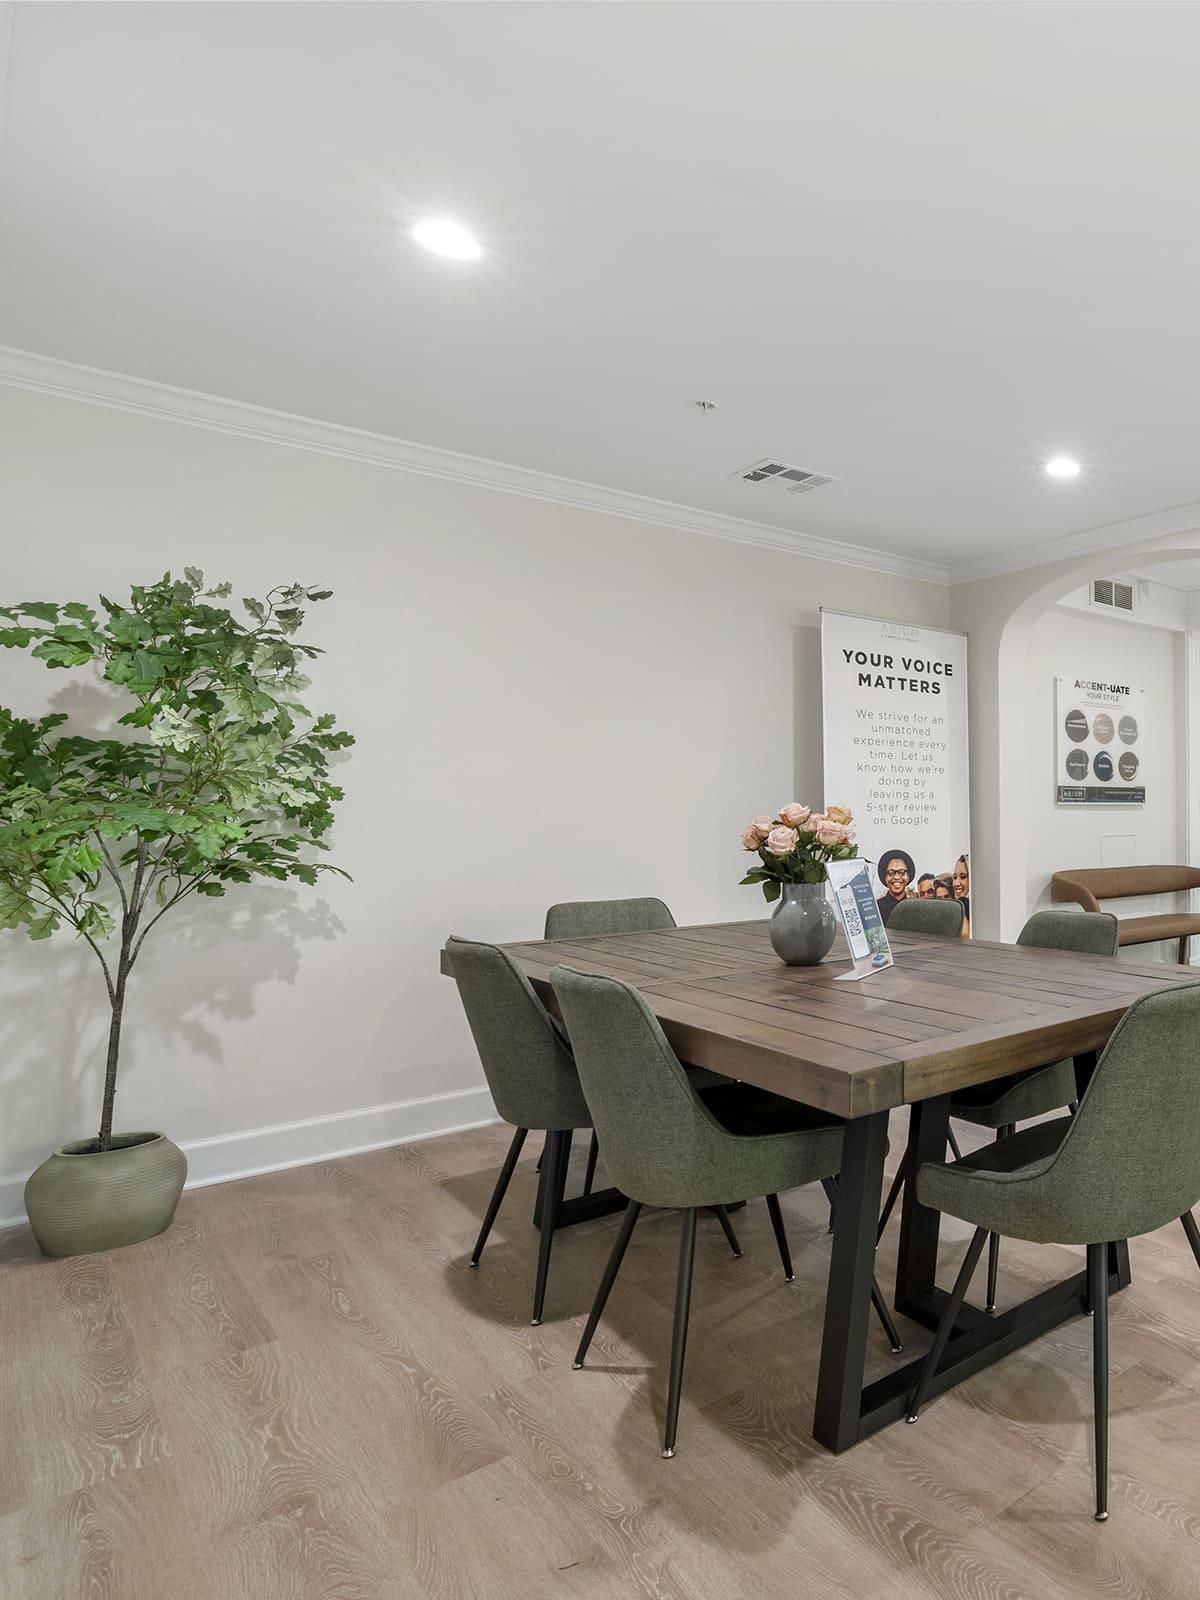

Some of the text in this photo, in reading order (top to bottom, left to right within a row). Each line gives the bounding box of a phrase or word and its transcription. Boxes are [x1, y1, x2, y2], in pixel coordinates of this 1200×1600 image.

[842, 649, 953, 676] YOUR VOICE
[858, 672, 941, 694] MATTERS
[1074, 680, 1130, 695] ACCENT-UATE
[1087, 692, 1120, 702] YOUR STYLE
[855, 708, 944, 725] We strive for an
[871, 725, 931, 736] unmatched
[853, 737, 946, 751] experience every
[869, 750, 897, 760] time.
[901, 751, 918, 761] Let
[857, 762, 945, 774] know how we're
[878, 777, 926, 787] doing by
[869, 789, 935, 800] leaving us a
[866, 802, 937, 812] 5-star review
[872, 815, 929, 826] on Google
